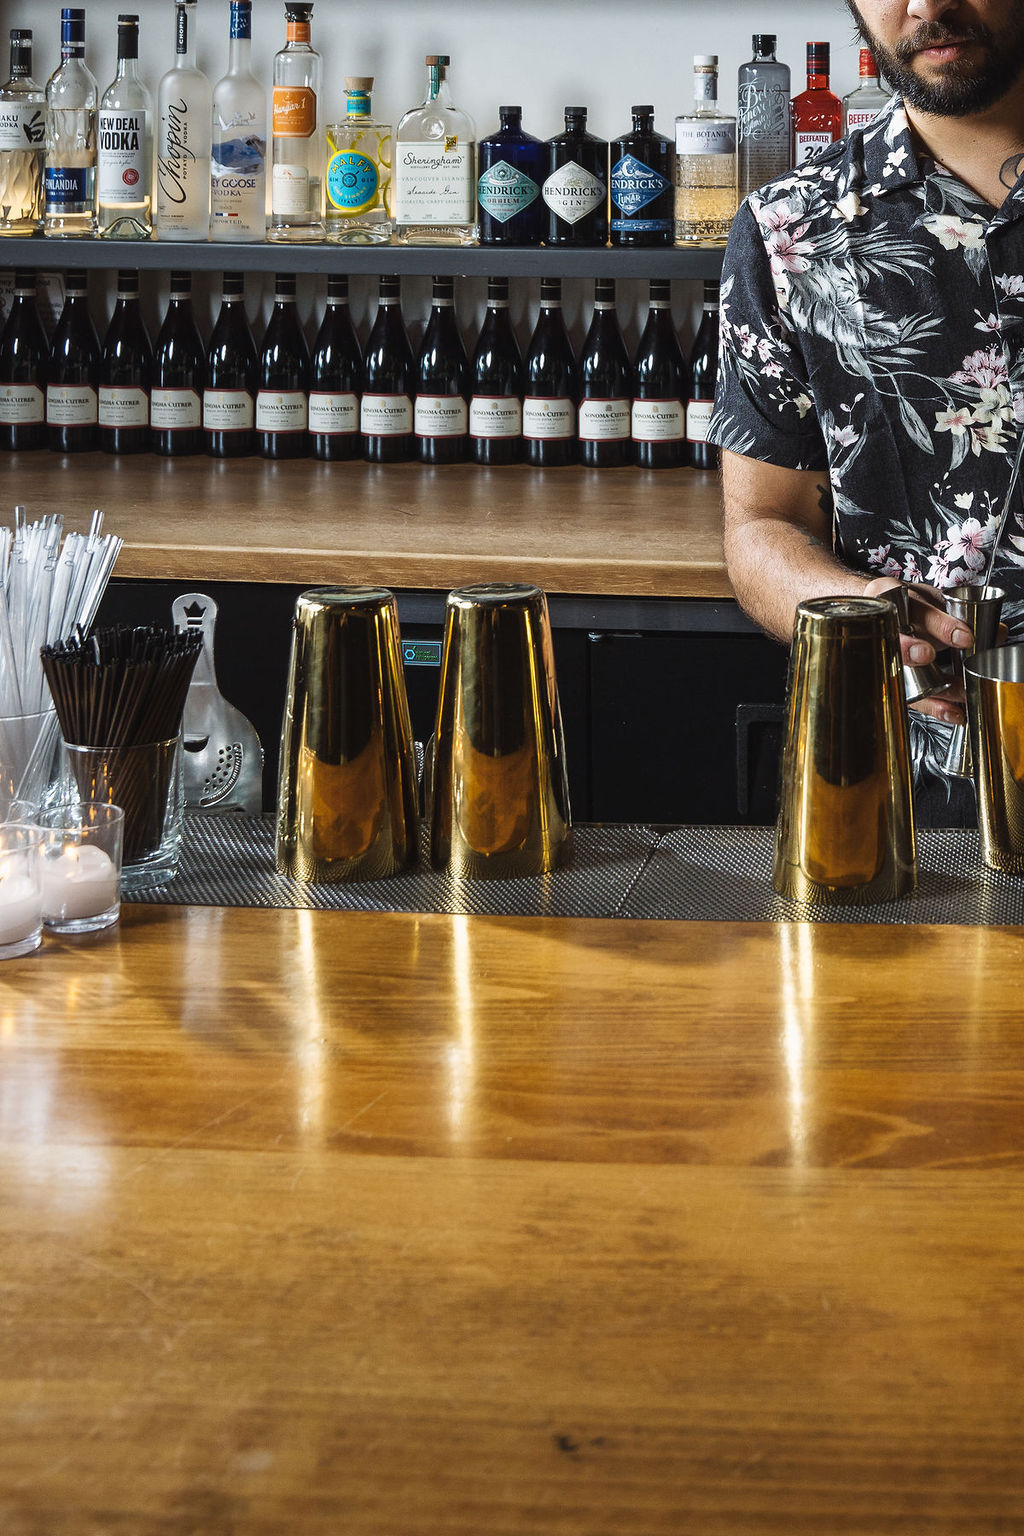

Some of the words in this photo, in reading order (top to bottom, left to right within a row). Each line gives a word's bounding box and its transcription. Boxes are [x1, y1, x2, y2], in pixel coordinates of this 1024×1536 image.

[100, 117, 115, 131] NEW
[115, 117, 140, 131] DEAL
[100, 131, 140, 151] VODKA
[799, 135, 829, 144] BEEFEATER
[158, 98, 188, 204] Chopin
[331, 155, 372, 173] MALFY
[403, 152, 462, 170] Sheringham
[46, 179, 78, 190] FINLANDIA
[221, 179, 256, 188] GOOSE
[611, 179, 663, 189] ENDRICK'S
[478, 185, 534, 196] HENDRICK'S
[544, 185, 602, 197] HENDRICK'S
[617, 192, 641, 205] LUNAR
